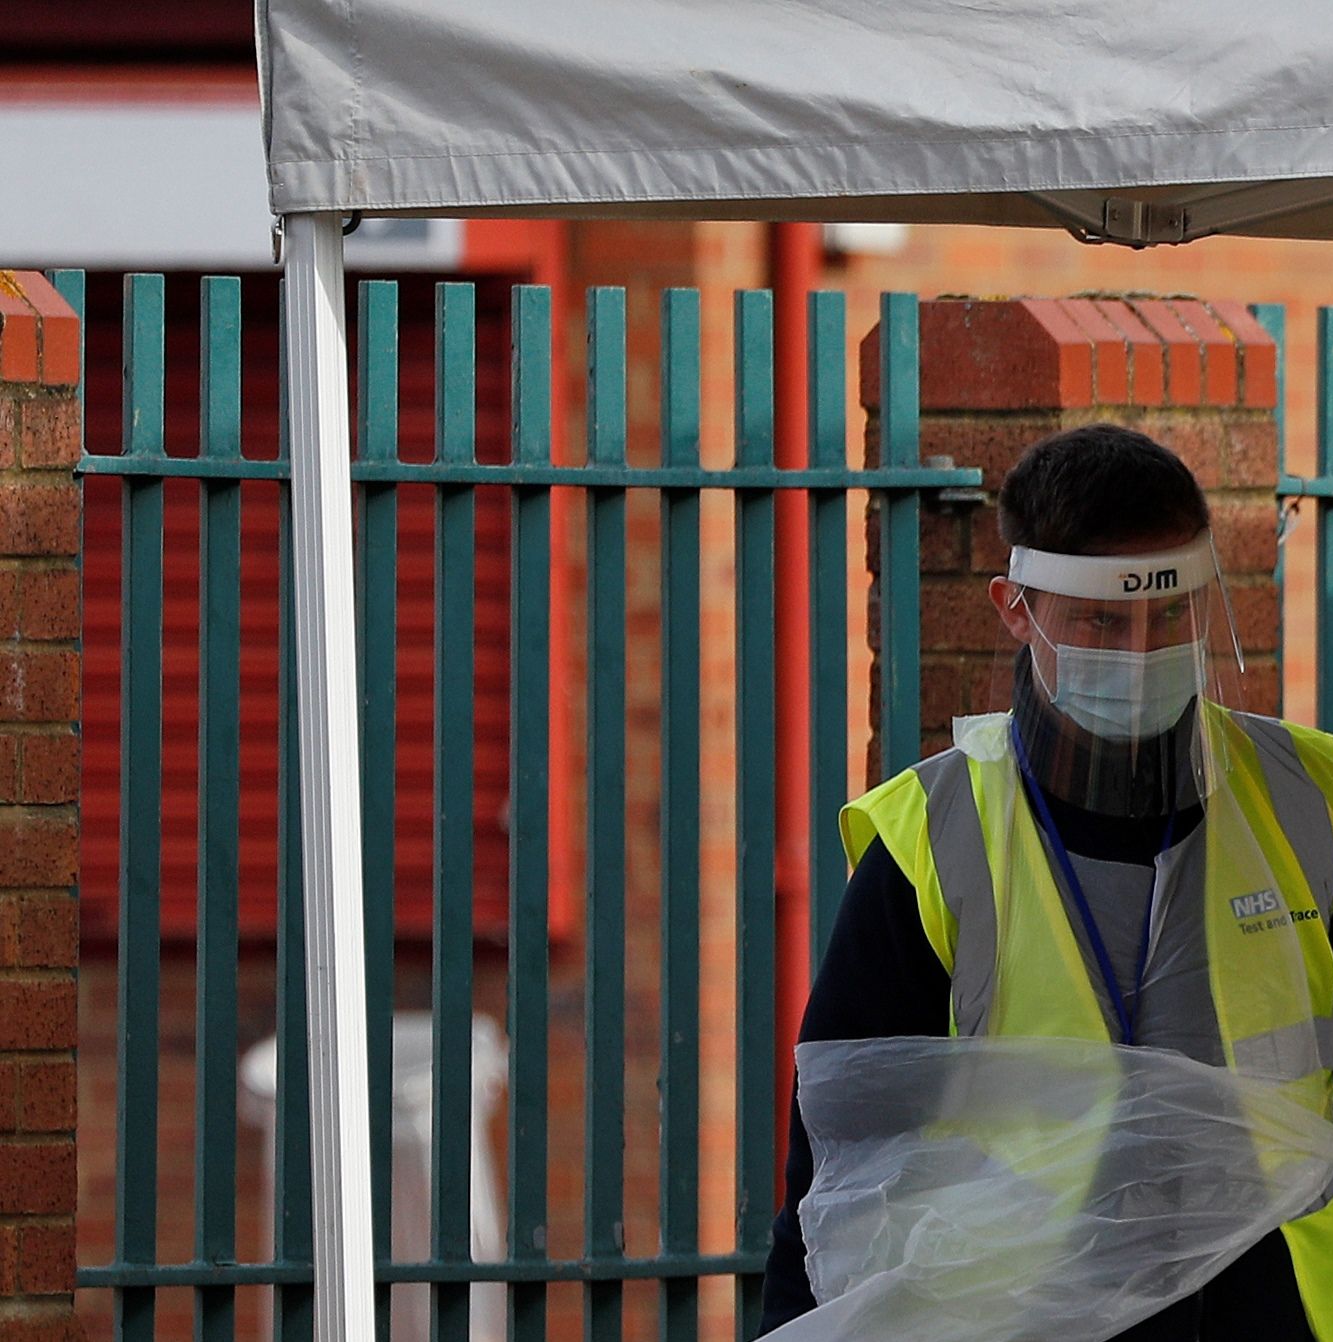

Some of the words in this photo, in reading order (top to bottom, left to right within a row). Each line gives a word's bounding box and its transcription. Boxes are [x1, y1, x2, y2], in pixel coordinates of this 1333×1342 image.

[1233, 889, 1279, 918] NHS
[1239, 921, 1264, 935] Test
[1266, 915, 1288, 930] and
